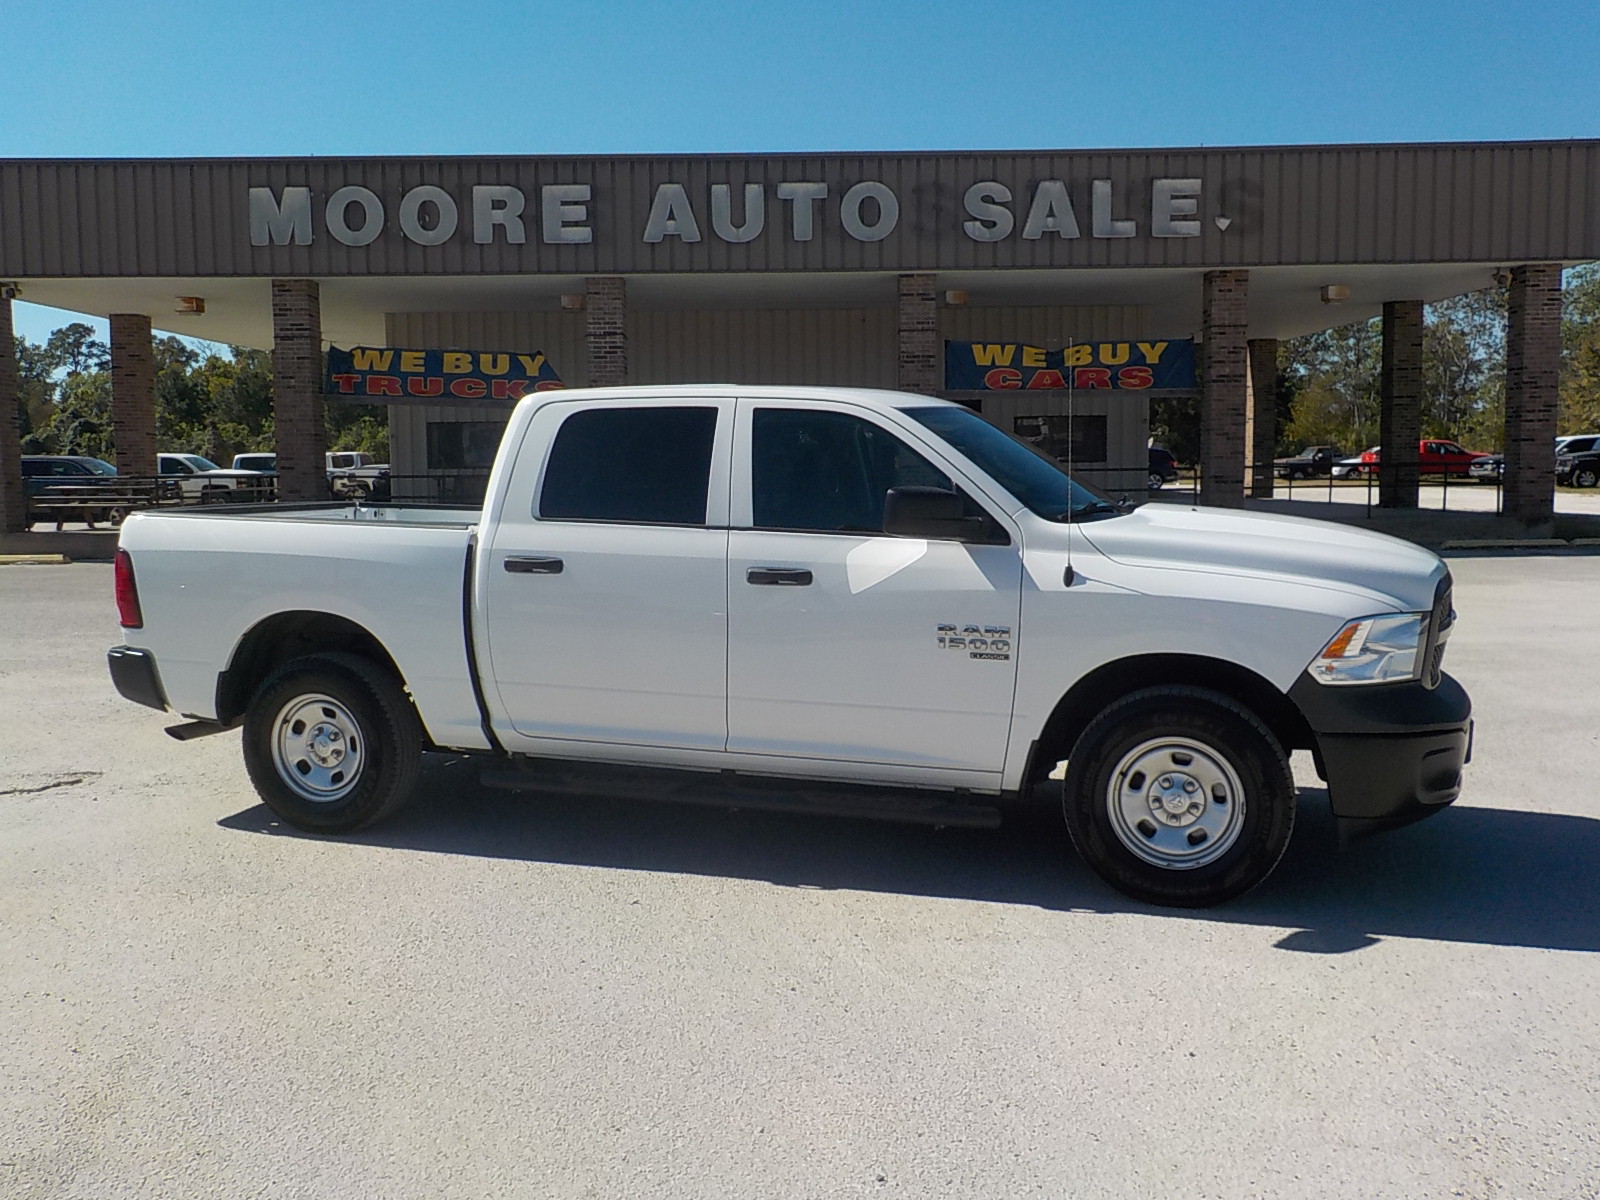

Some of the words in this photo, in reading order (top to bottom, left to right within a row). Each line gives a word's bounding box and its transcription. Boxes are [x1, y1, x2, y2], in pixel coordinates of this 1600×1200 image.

[249, 184, 592, 247] MOORE
[643, 181, 899, 244] AUTO
[353, 349, 426, 372] WE
[443, 352, 545, 377] BUY
[972, 344, 1047, 367] WE
[1065, 342, 1168, 366] BUY
[984, 367, 1154, 390] CARS
[937, 624, 1011, 639] RAM
[937, 637, 1010, 652] 1500
